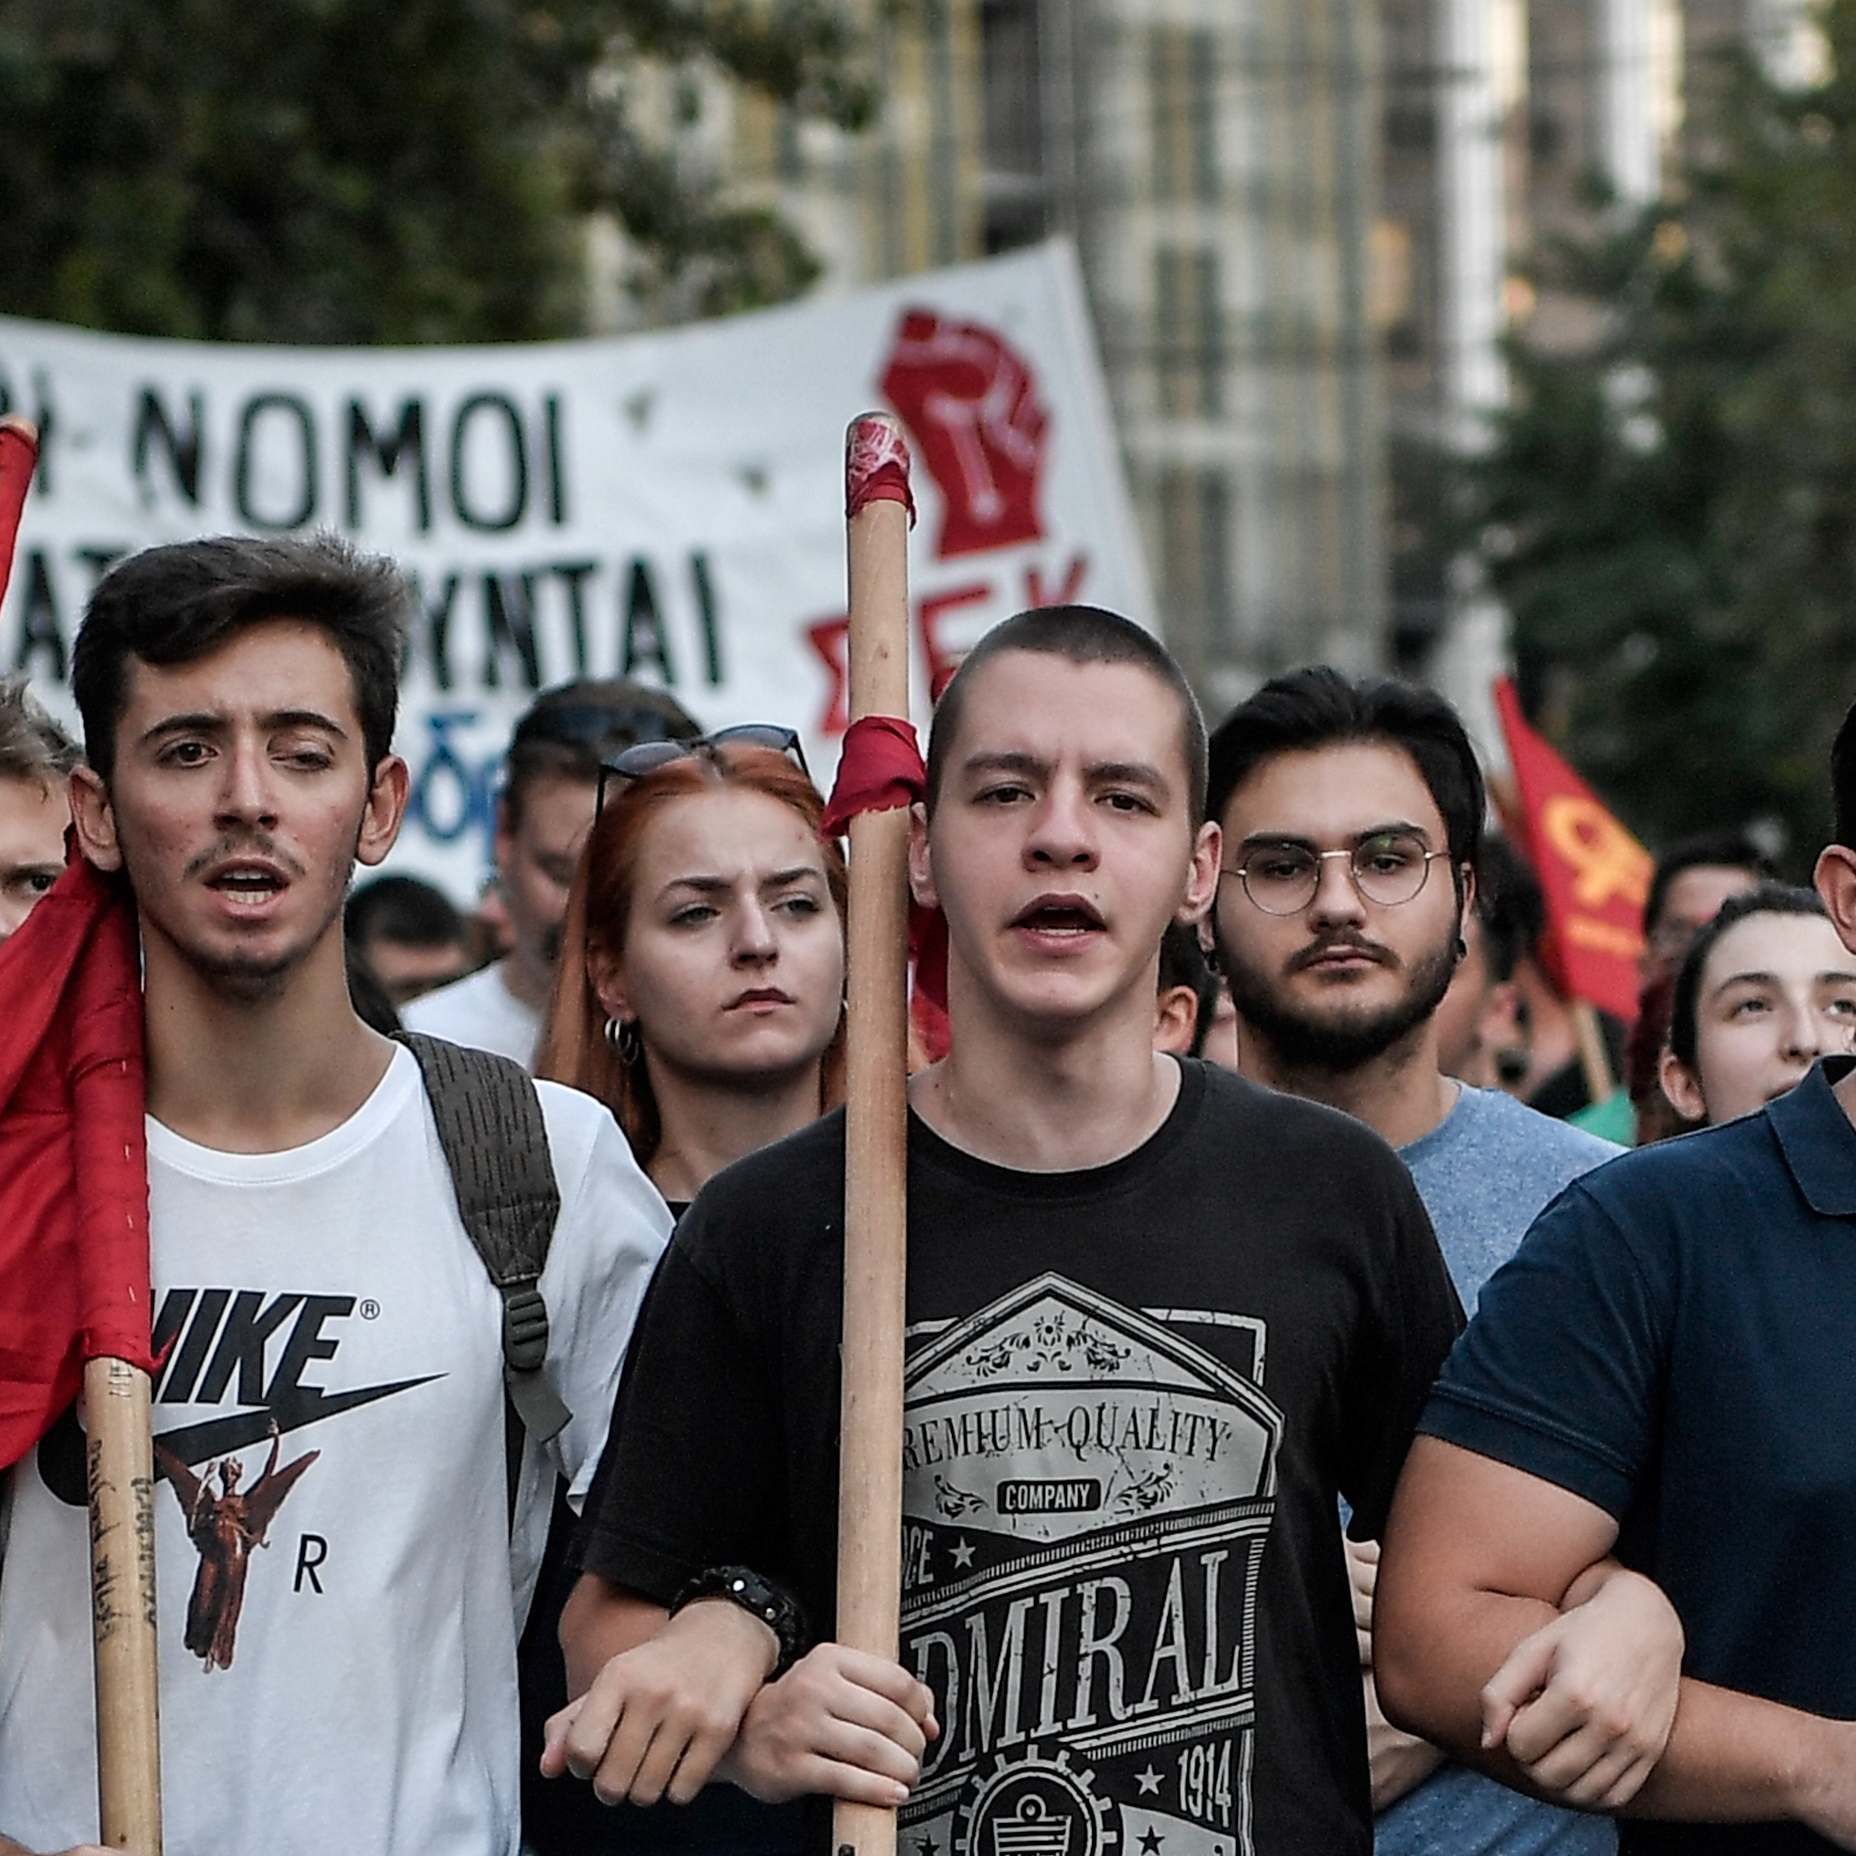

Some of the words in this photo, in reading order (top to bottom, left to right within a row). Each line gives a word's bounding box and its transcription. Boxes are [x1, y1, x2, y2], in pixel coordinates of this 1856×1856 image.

[130, 384, 569, 534] ΝΟΜΟΙ
[903, 1404, 1044, 1472] REMIUM
[1066, 1402, 1231, 1463] QUALITY
[1005, 1483, 1091, 1511] COMPANY
[293, 1533, 328, 1595] R
[909, 1549, 1242, 1779] DMIRAL
[1177, 1738, 1233, 1828] 1914
